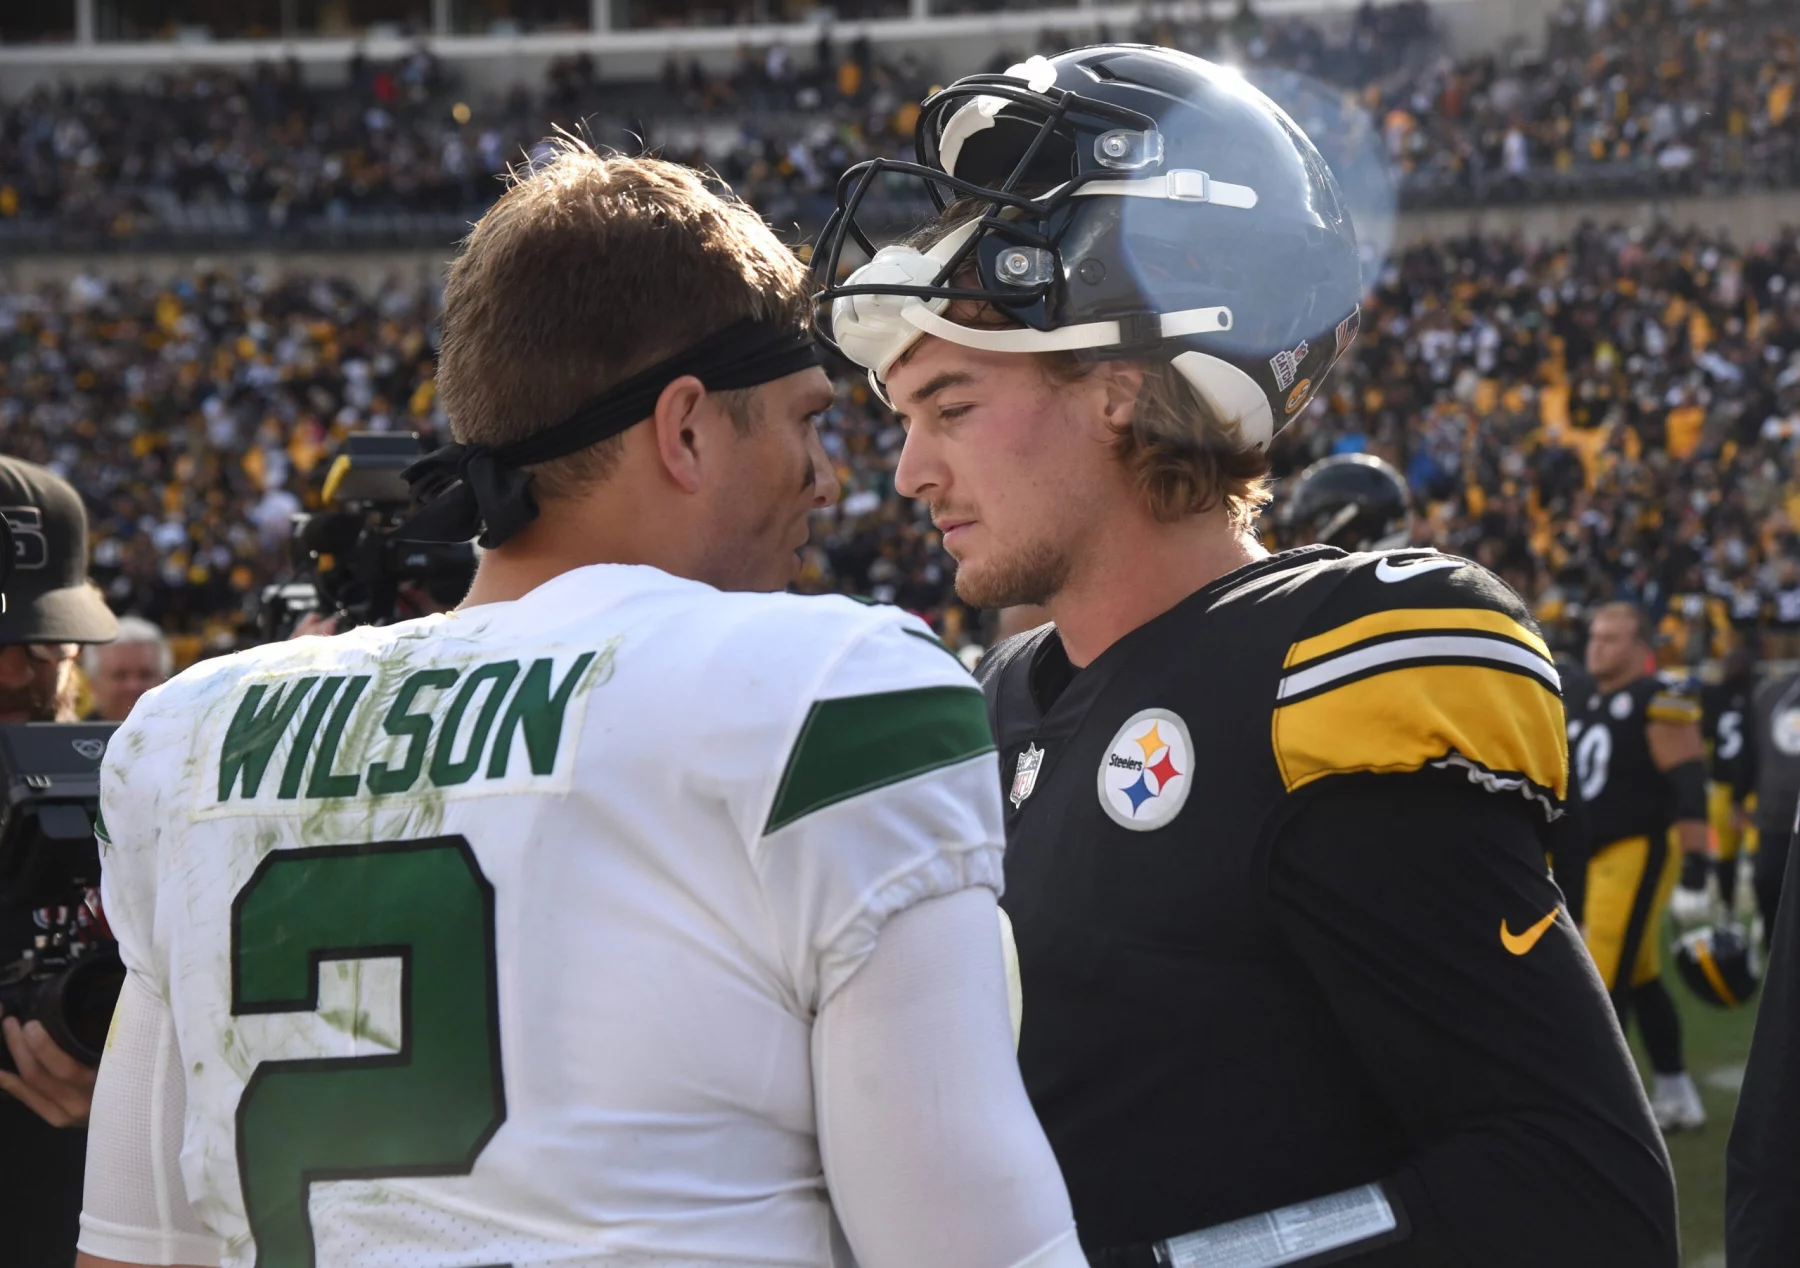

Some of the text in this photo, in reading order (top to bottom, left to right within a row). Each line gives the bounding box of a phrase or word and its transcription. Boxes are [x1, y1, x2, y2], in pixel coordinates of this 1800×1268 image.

[1275, 353, 1293, 387] CATCH
[1288, 383, 1310, 409] 3
[217, 651, 597, 802] WILSON
[1109, 753, 1143, 772] Steelers
[231, 834, 512, 1268] 2
